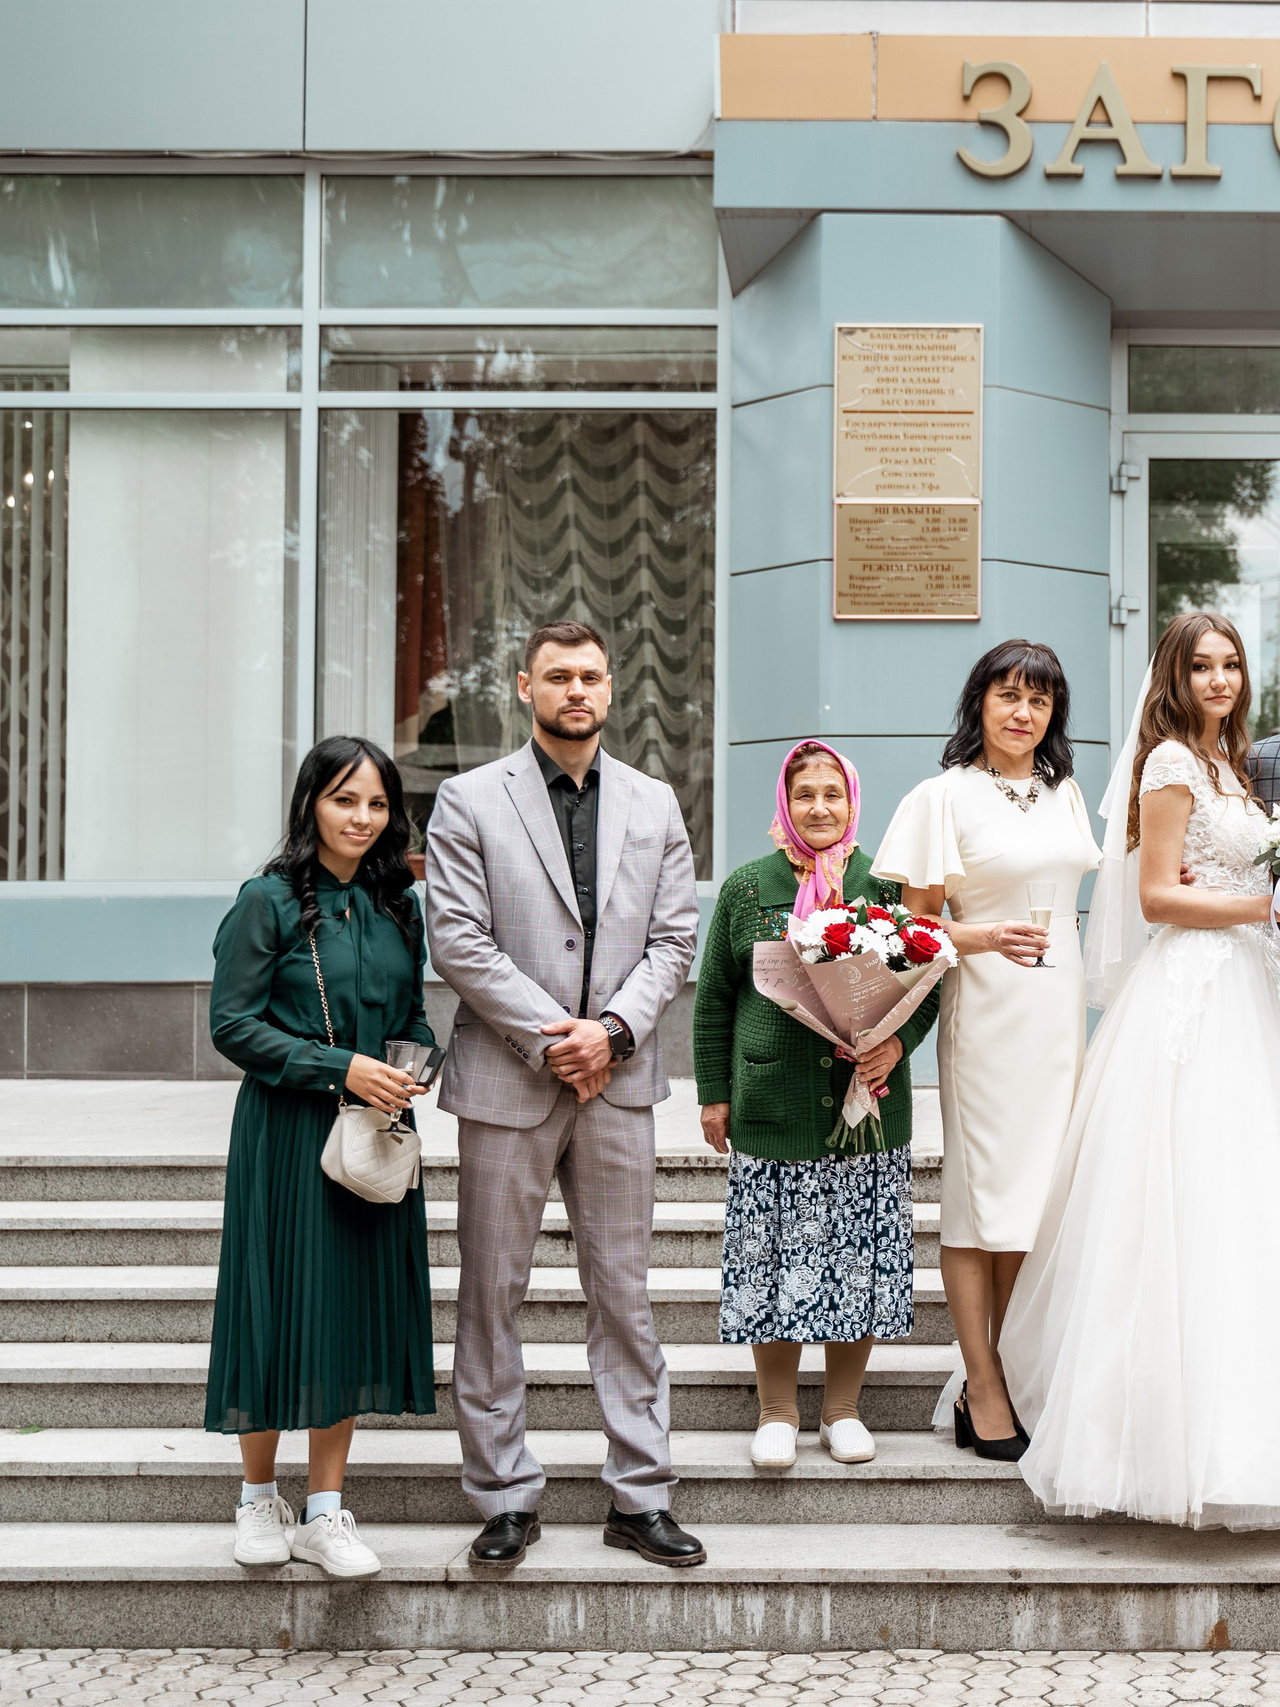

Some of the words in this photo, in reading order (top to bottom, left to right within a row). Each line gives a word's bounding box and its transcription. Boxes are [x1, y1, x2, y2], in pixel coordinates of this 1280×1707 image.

[880, 399, 903, 407] ЗАГС
[911, 456, 937, 465] ЗАГС
[921, 481, 941, 492] Уфа
[862, 563, 903, 573] РЕЖИМ
